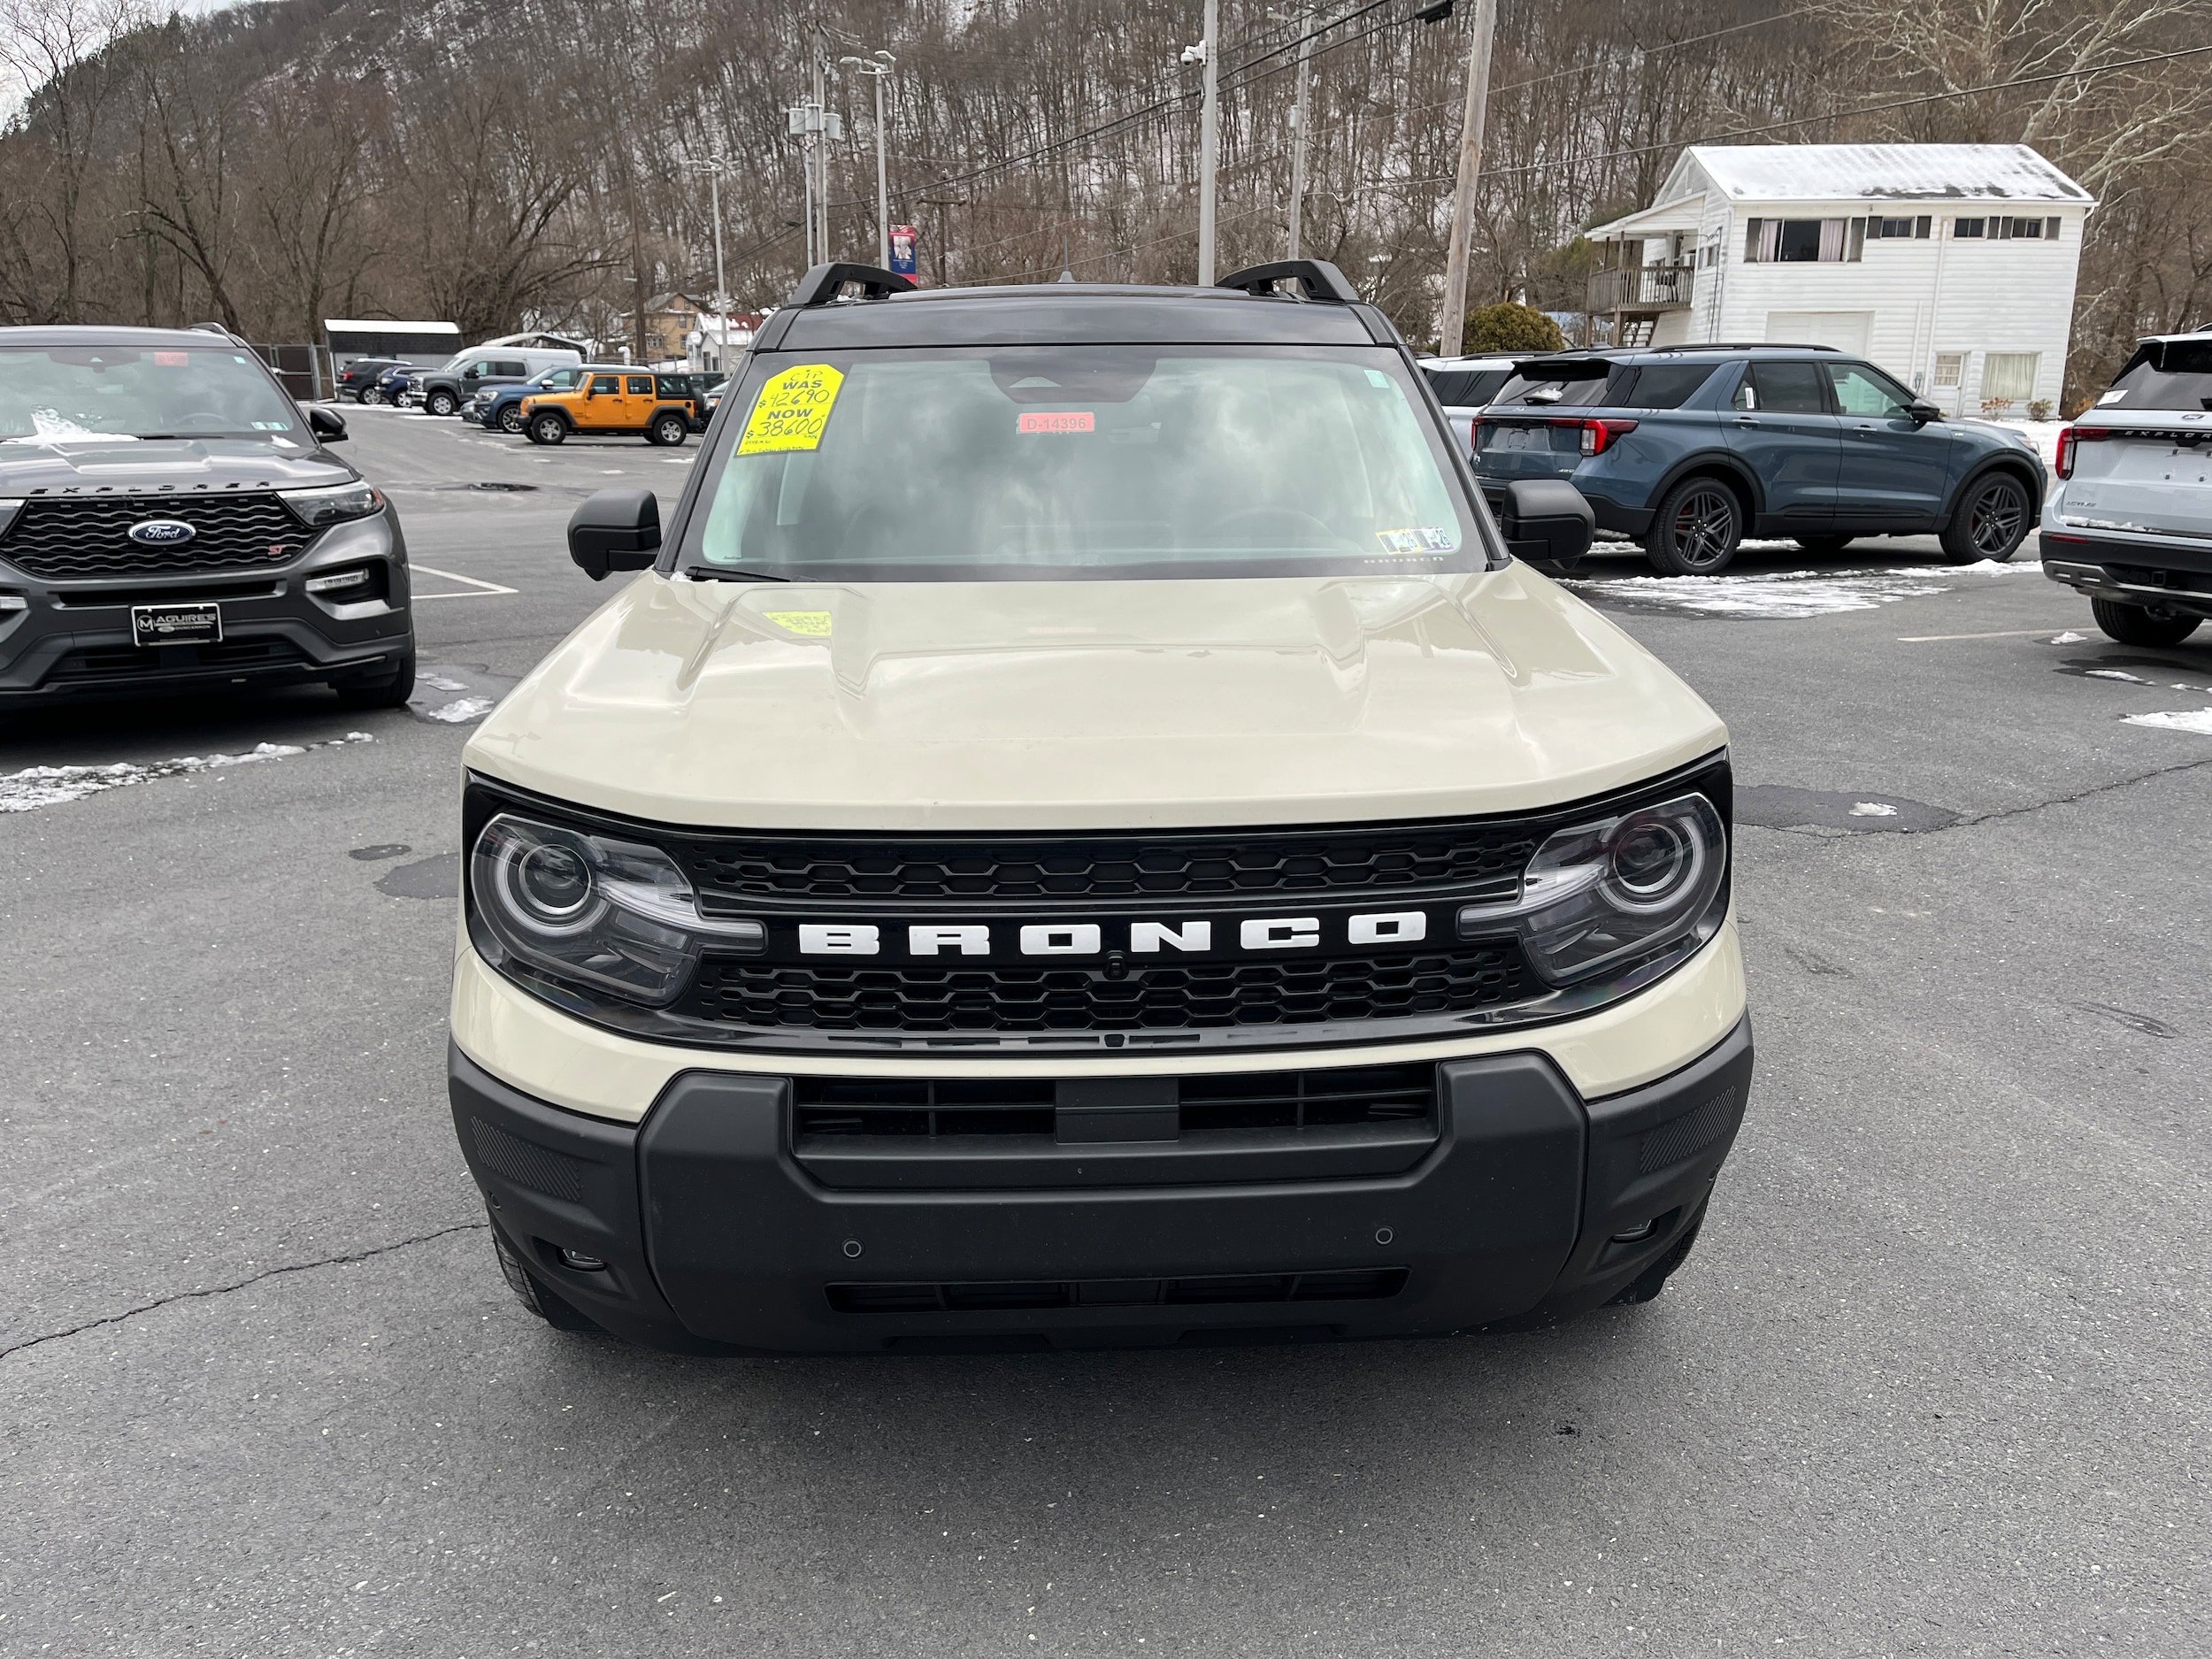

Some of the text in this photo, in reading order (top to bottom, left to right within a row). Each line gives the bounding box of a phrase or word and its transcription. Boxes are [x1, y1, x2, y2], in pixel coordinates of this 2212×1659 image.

[783, 380, 823, 389] WAS
[766, 408, 814, 419] NOW
[1026, 418, 1087, 430] D-14396
[29, 480, 270, 495] EXPLORER
[145, 525, 180, 539] Ford
[798, 910, 1427, 956] BRONCO
